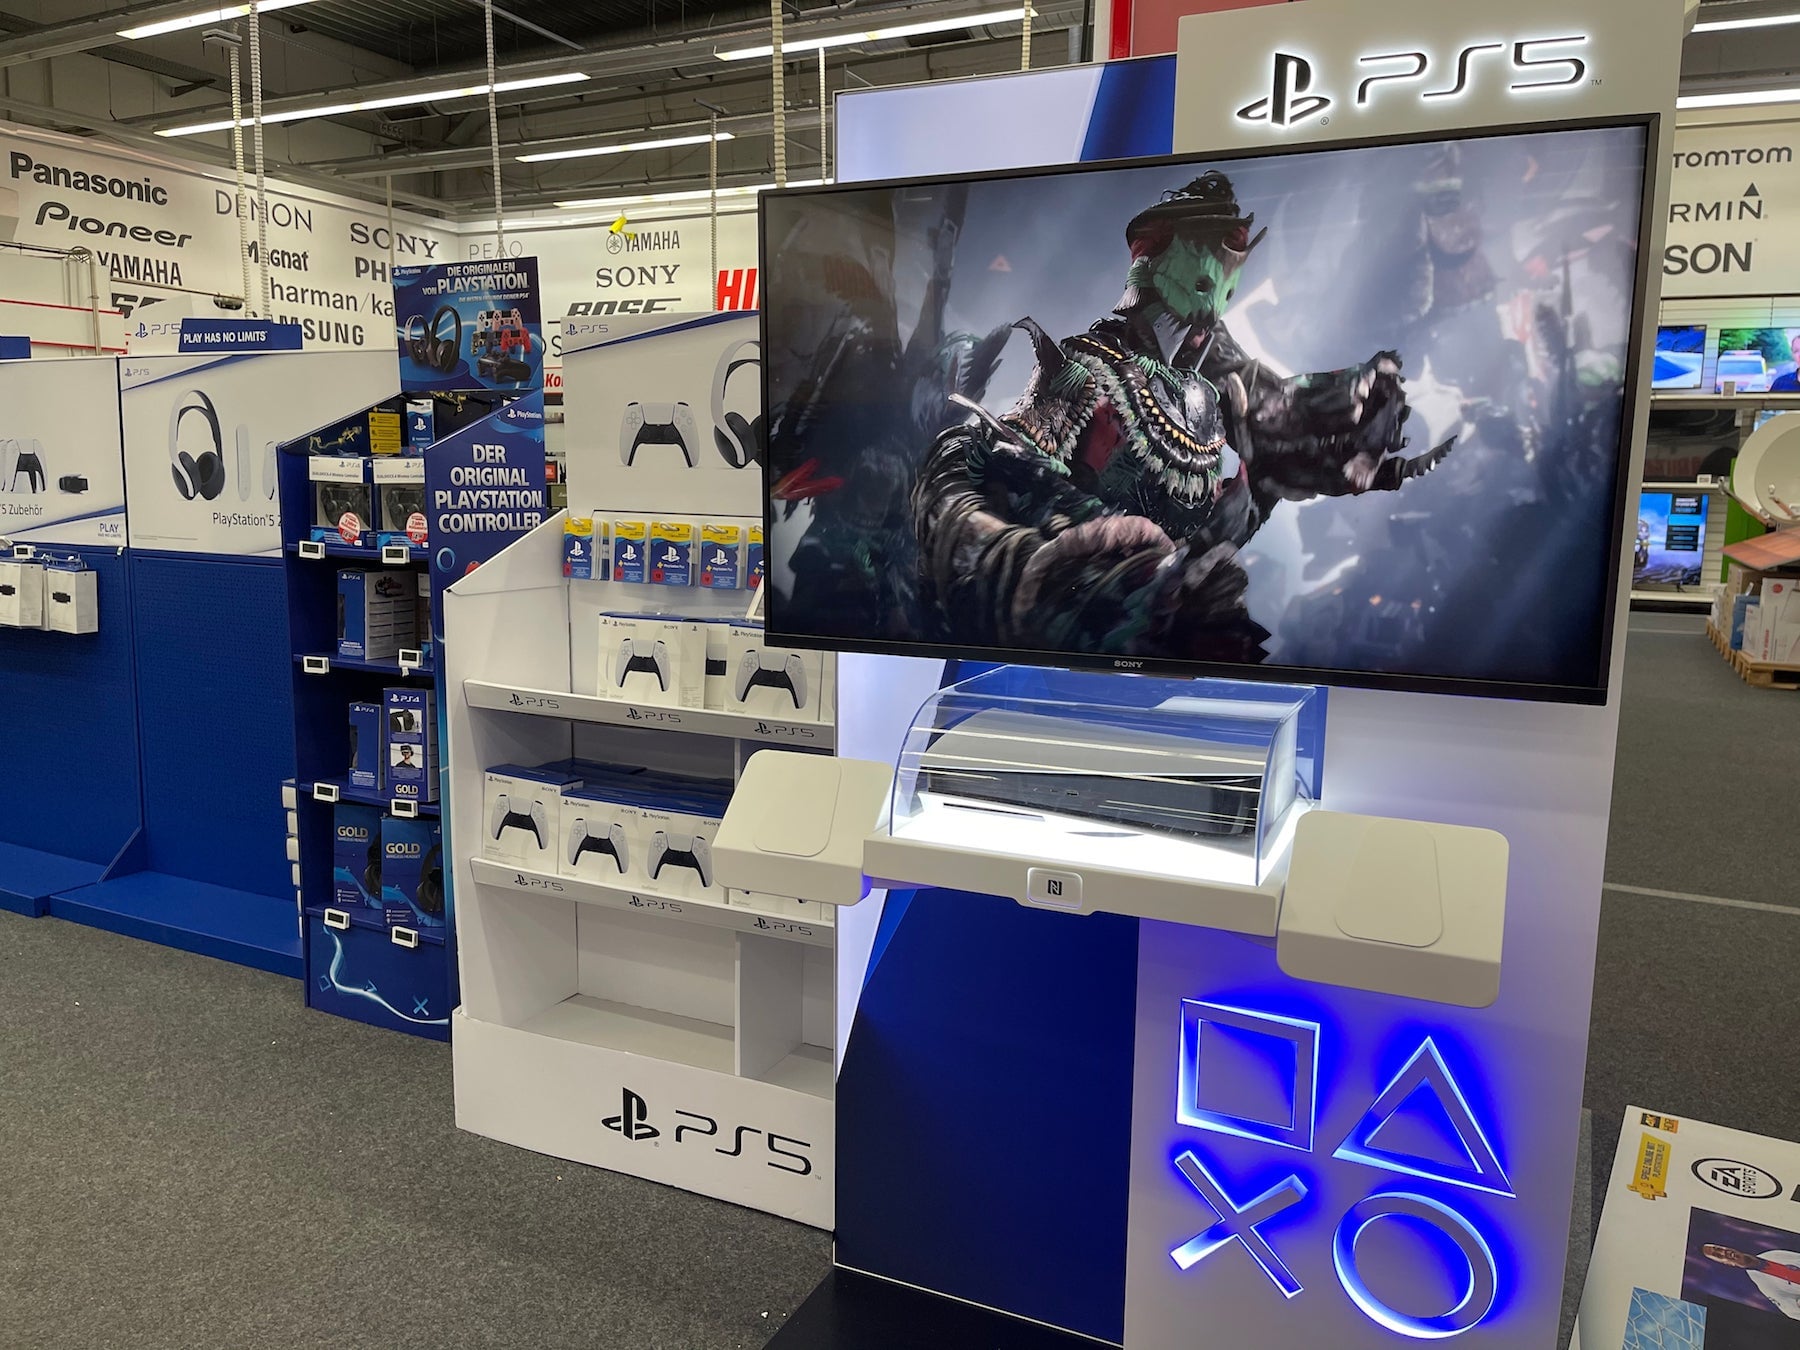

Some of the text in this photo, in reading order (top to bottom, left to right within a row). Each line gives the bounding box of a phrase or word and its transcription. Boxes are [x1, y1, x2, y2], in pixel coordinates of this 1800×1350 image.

[1356, 35, 1588, 105] PS5
[10, 151, 168, 206] Panasonic
[35, 201, 192, 249] Pioneer
[350, 222, 439, 258] SONY
[624, 230, 680, 252] YAMAHA
[97, 251, 183, 286] YAMAHA
[447, 261, 516, 277] DIE ORIGINALEN
[596, 264, 681, 288] SONY
[422, 272, 528, 295] VON PLAYSTATION
[717, 268, 759, 311] HI
[151, 322, 181, 336] PS5
[580, 324, 609, 334] PS5
[183, 330, 266, 344] PLAY HAS NO LIMITS
[517, 410, 543, 420] PlayStation
[472, 444, 507, 464] DER
[450, 466, 530, 486] ORIGINAL
[435, 490, 543, 510] PLAYSTATION
[9, 503, 43, 516] Zubehör
[100, 523, 119, 533] PLAY
[438, 512, 542, 533] CONTROLLER
[1114, 659, 1144, 669] SONY
[400, 695, 420, 703] PS4
[525, 696, 560, 709] PS5
[645, 710, 682, 723] PS5
[774, 726, 815, 739] PS5
[395, 783, 419, 795] GOLD
[337, 825, 369, 838] GOLD
[385, 843, 421, 854] GOLD
[531, 878, 564, 892] PS5
[646, 899, 683, 913] PS5
[773, 921, 812, 936] PS5
[675, 1109, 812, 1176] PS5
[1711, 1167, 1742, 1190] EA
[1742, 1168, 1757, 1194] SPORTS
